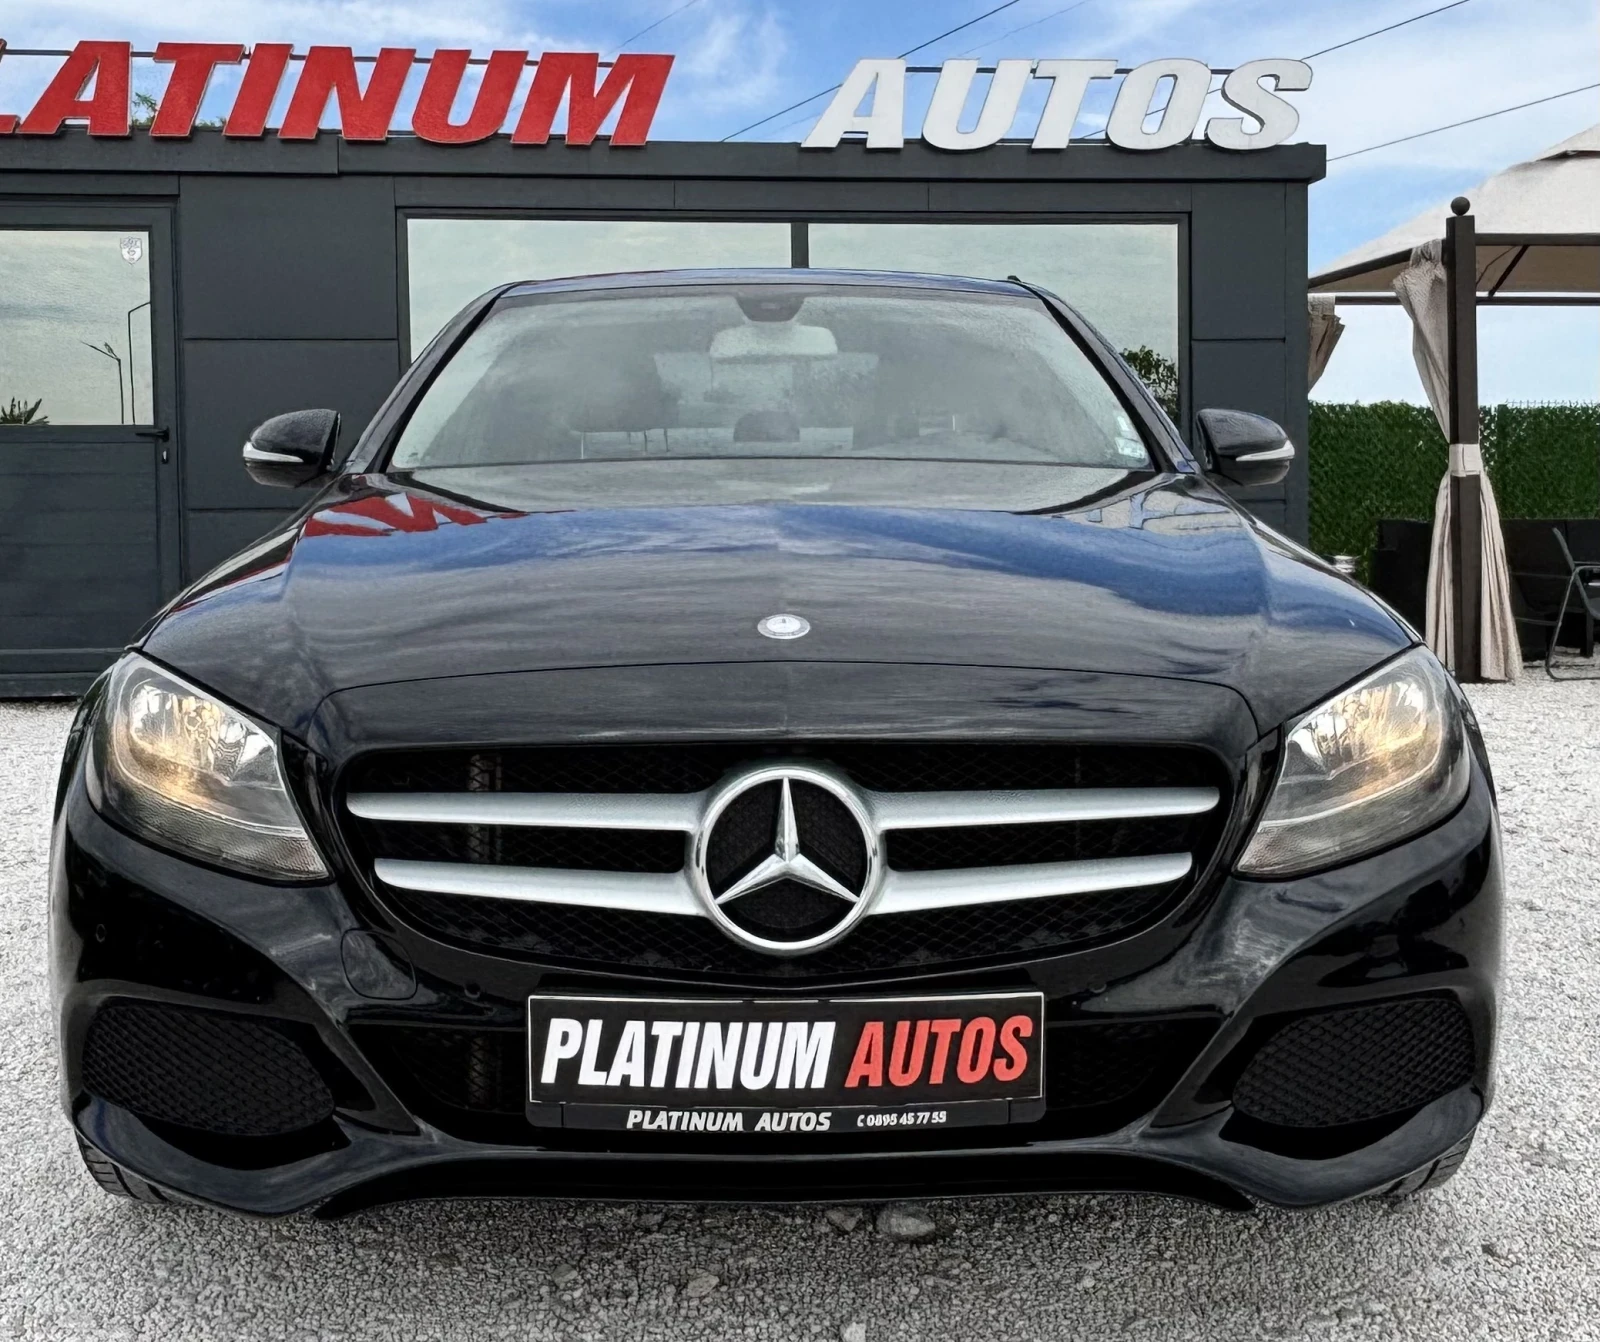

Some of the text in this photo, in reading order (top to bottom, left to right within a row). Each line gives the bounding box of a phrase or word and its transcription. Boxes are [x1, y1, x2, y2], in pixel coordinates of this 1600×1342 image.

[800, 57, 1314, 151] AUTOS
[540, 1014, 1034, 1091] PLATINUM AUTOS
[626, 1109, 744, 1132] PLATINUM
[754, 1111, 832, 1132] AUTOS
[899, 1112, 915, 1125] 45
[916, 1111, 931, 1125] 77
